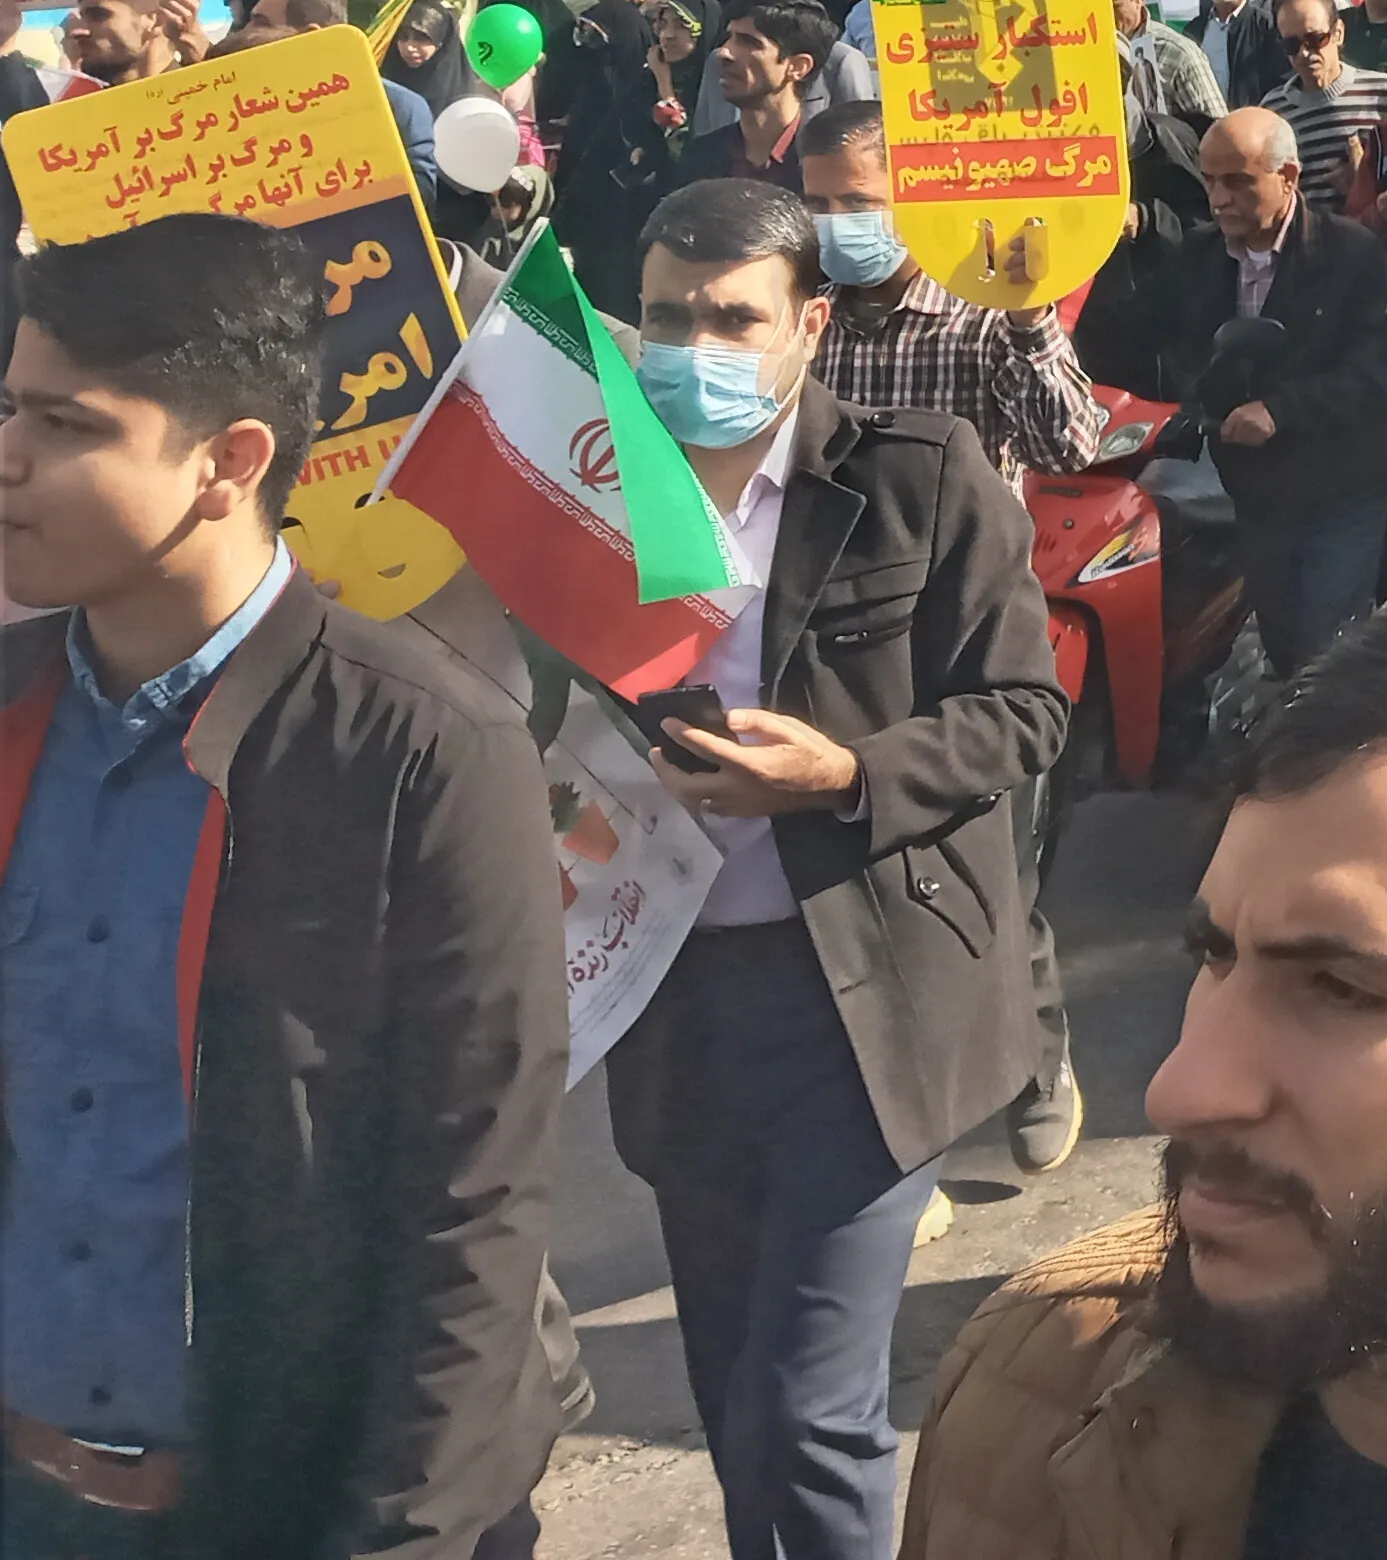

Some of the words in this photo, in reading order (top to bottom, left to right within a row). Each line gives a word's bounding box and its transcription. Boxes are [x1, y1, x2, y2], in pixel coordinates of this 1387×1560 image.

[886, 24, 980, 64] ستیزی
[991, 12, 1098, 60] استکبار
[166, 81, 209, 105] خمینی
[213, 71, 237, 90] امام
[286, 73, 350, 113] همین
[226, 87, 280, 132] شعار
[908, 81, 1008, 131] آمریکا
[1020, 80, 1088, 127] افول
[133, 128, 156, 159] بر
[157, 109, 219, 142] مرگ
[299, 134, 314, 158] و
[38, 126, 121, 172] آمریکا
[205, 154, 228, 185] بر
[230, 136, 293, 168] مرگ
[897, 146, 1038, 193] صهیونیسم
[1044, 143, 1112, 187] مرگ
[105, 153, 197, 209] اسرائیل
[257, 165, 303, 207] آنها
[315, 158, 374, 197] برای
[324, 240, 392, 317] مر
